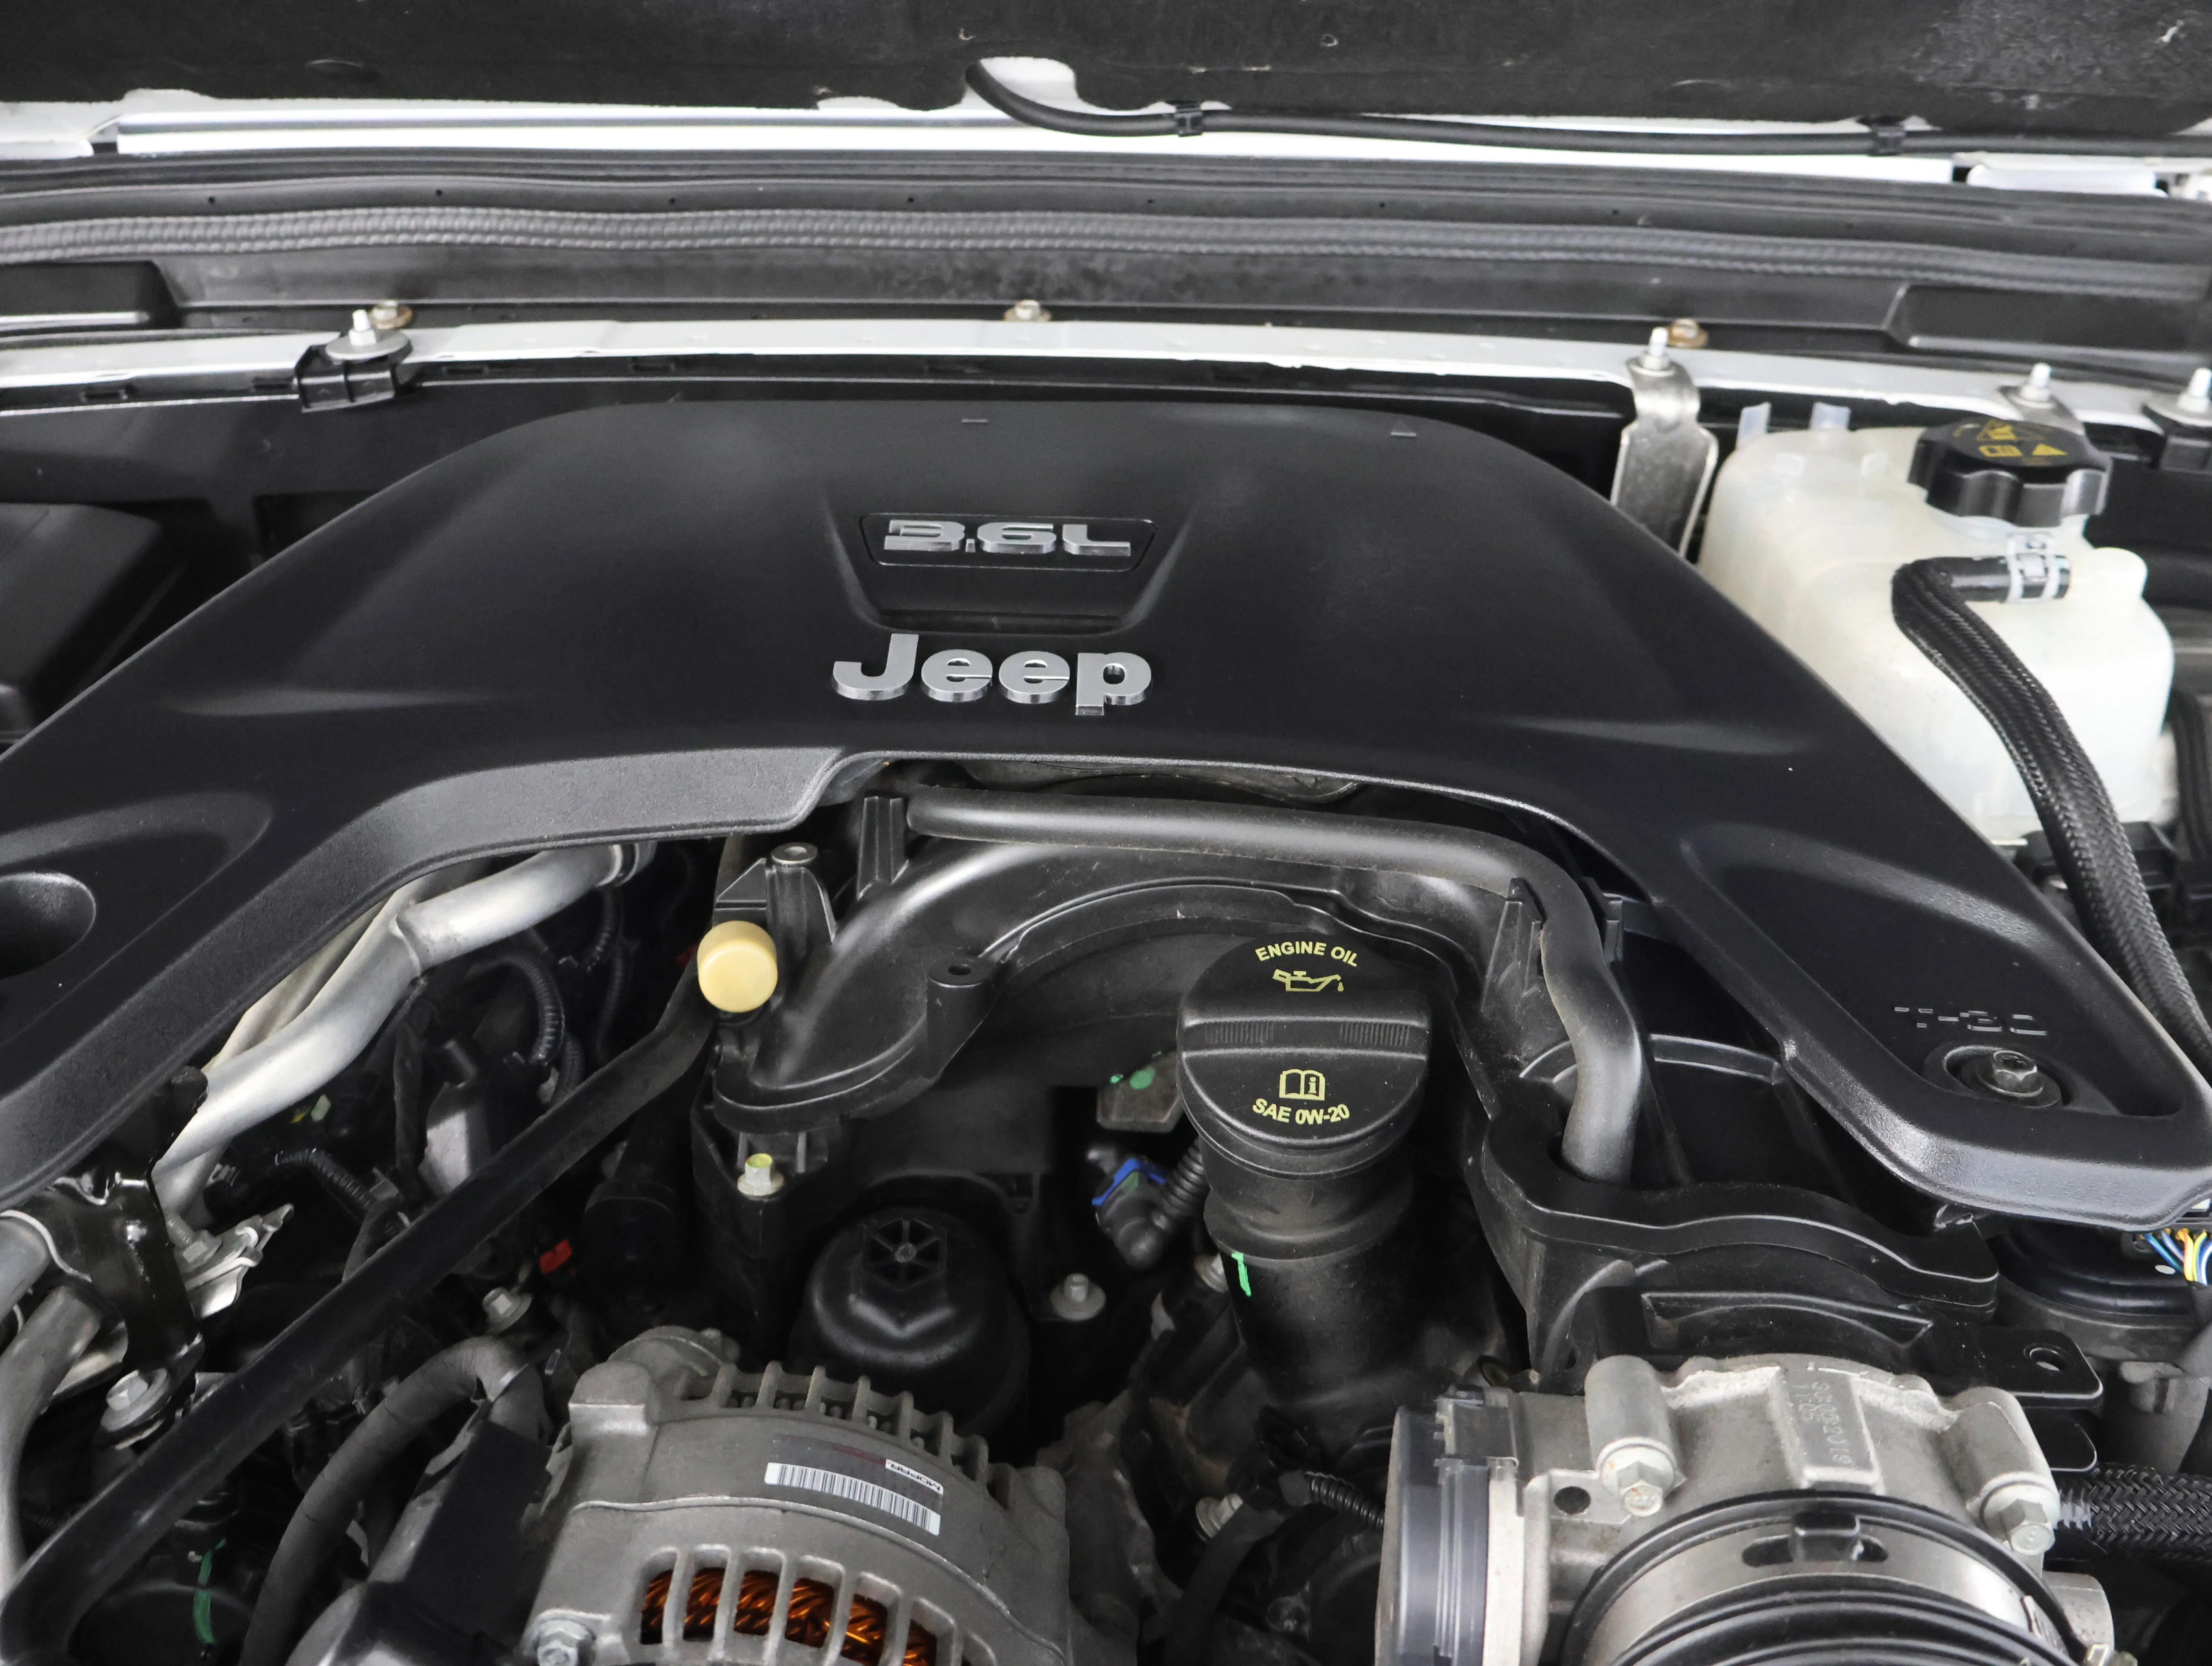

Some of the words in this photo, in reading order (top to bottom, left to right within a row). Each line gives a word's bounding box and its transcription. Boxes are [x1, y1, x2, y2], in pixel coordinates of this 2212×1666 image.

[884, 519, 1130, 556] 3.6L
[833, 633, 1151, 715] Jeep
[1255, 941, 1327, 961] ENGINE
[1331, 946, 1358, 967] OIL
[1252, 1098, 1292, 1123] SAE
[1295, 1104, 1350, 1125] 0W-20
[891, 1463, 940, 1491] MOPAR
